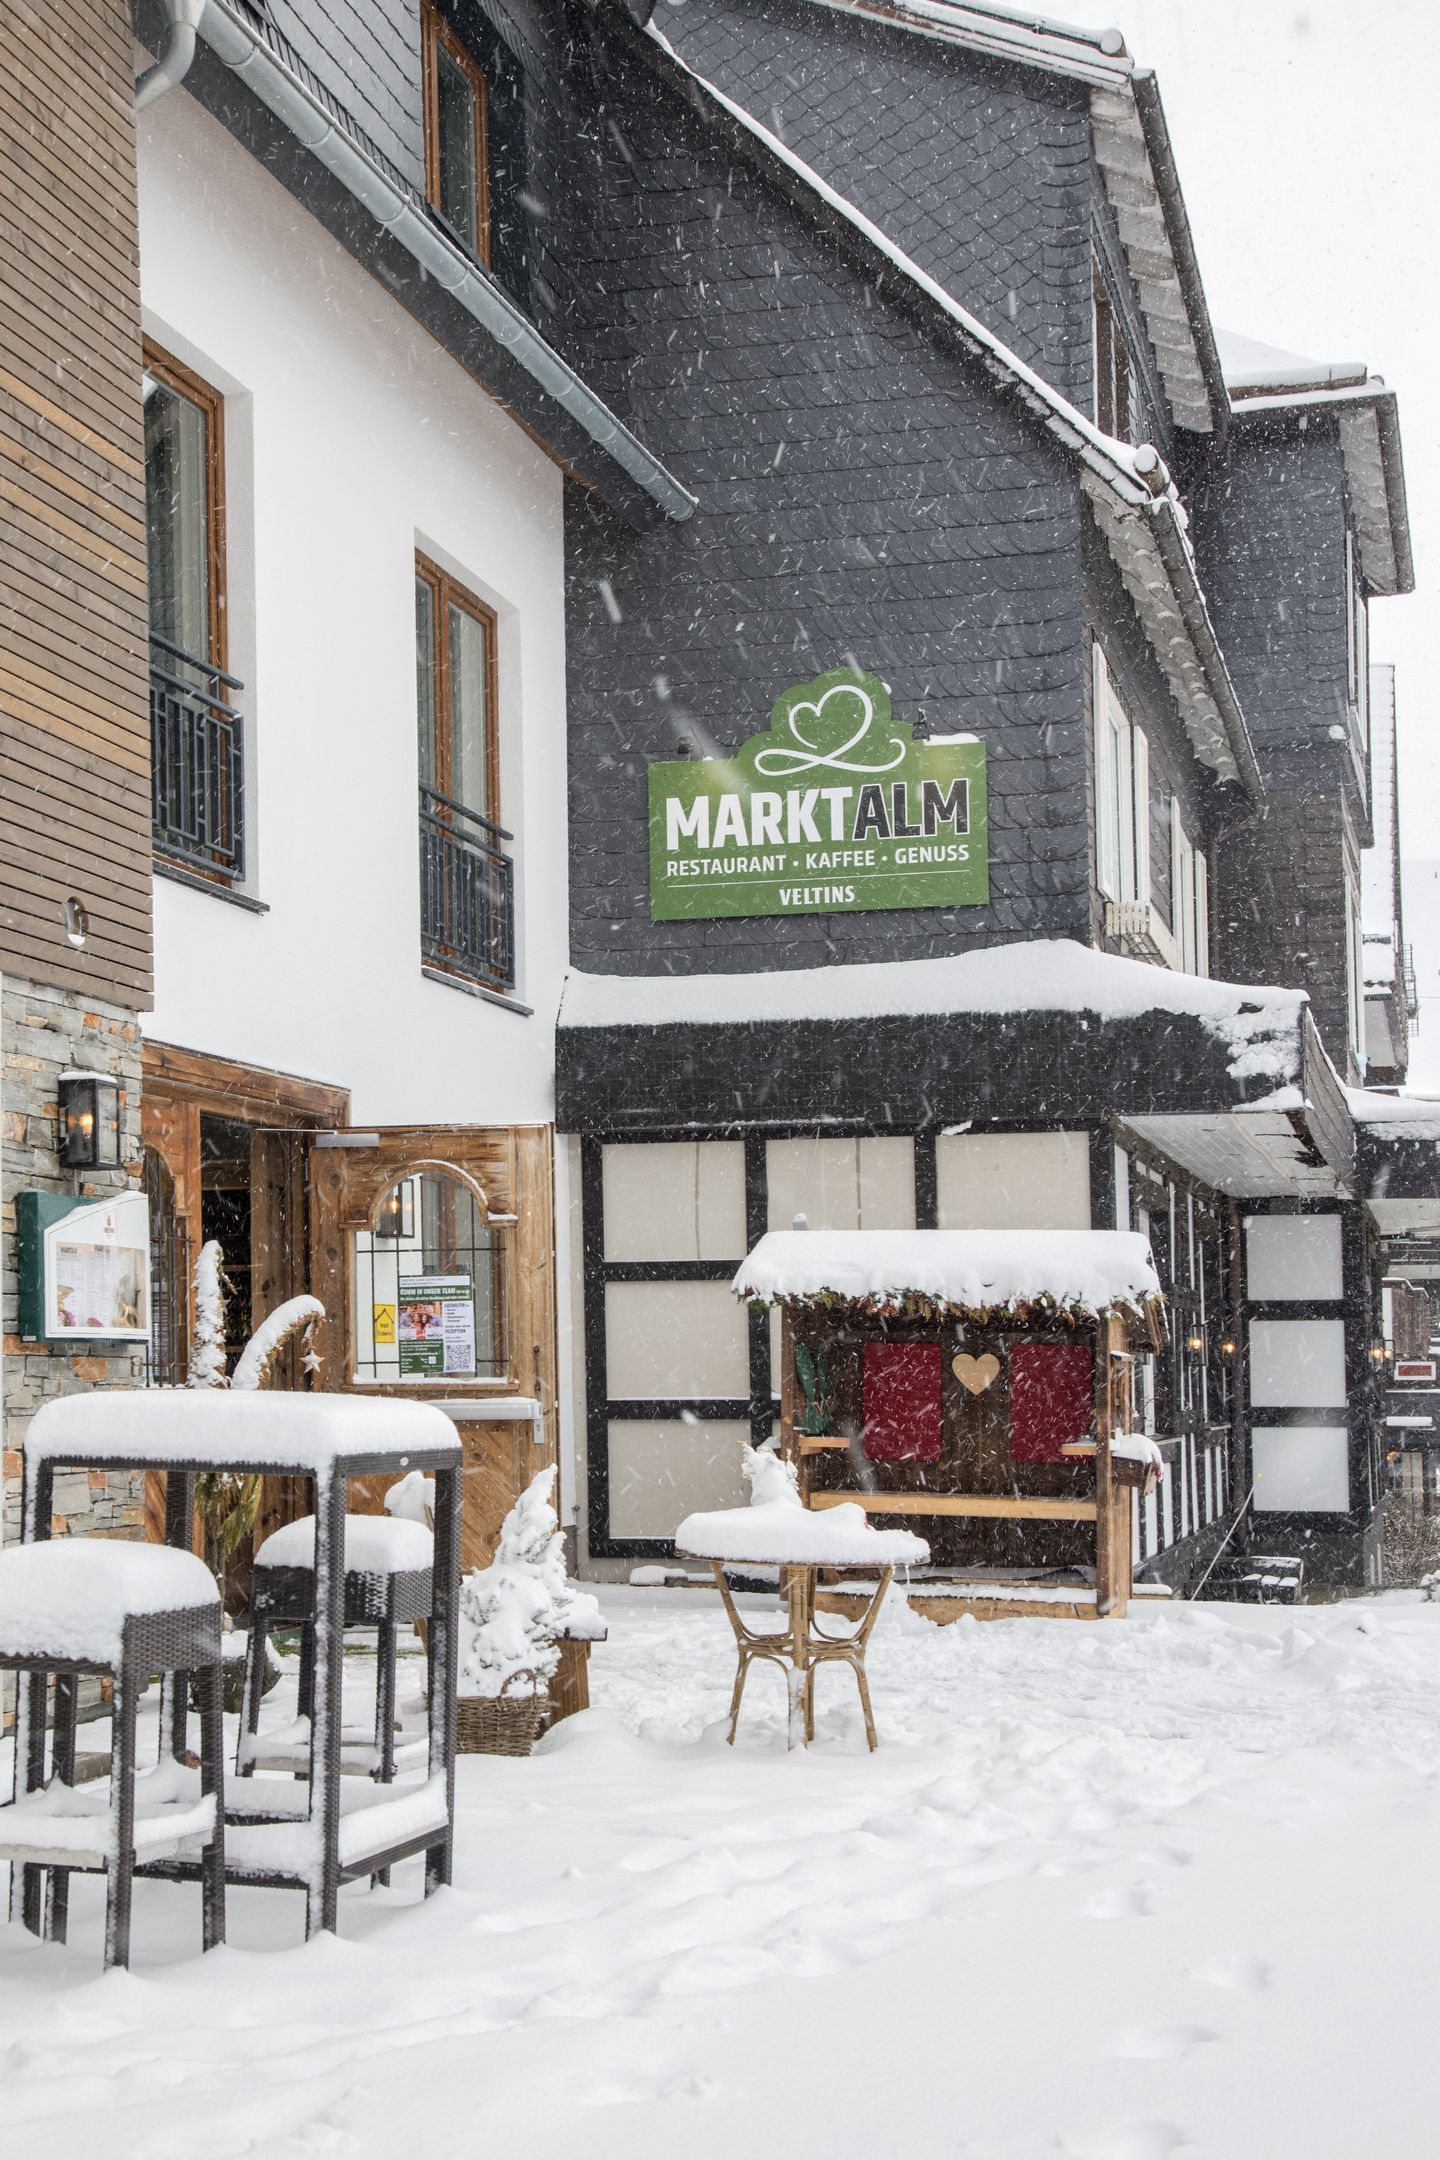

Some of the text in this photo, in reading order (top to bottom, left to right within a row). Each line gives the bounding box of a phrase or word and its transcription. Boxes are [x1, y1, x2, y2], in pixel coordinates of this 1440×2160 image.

[666, 777, 970, 850] MARKTALM
[667, 844, 970, 877] RESTAURANT KAFFEE GENUSS
[779, 885, 856, 906] VELTINS
